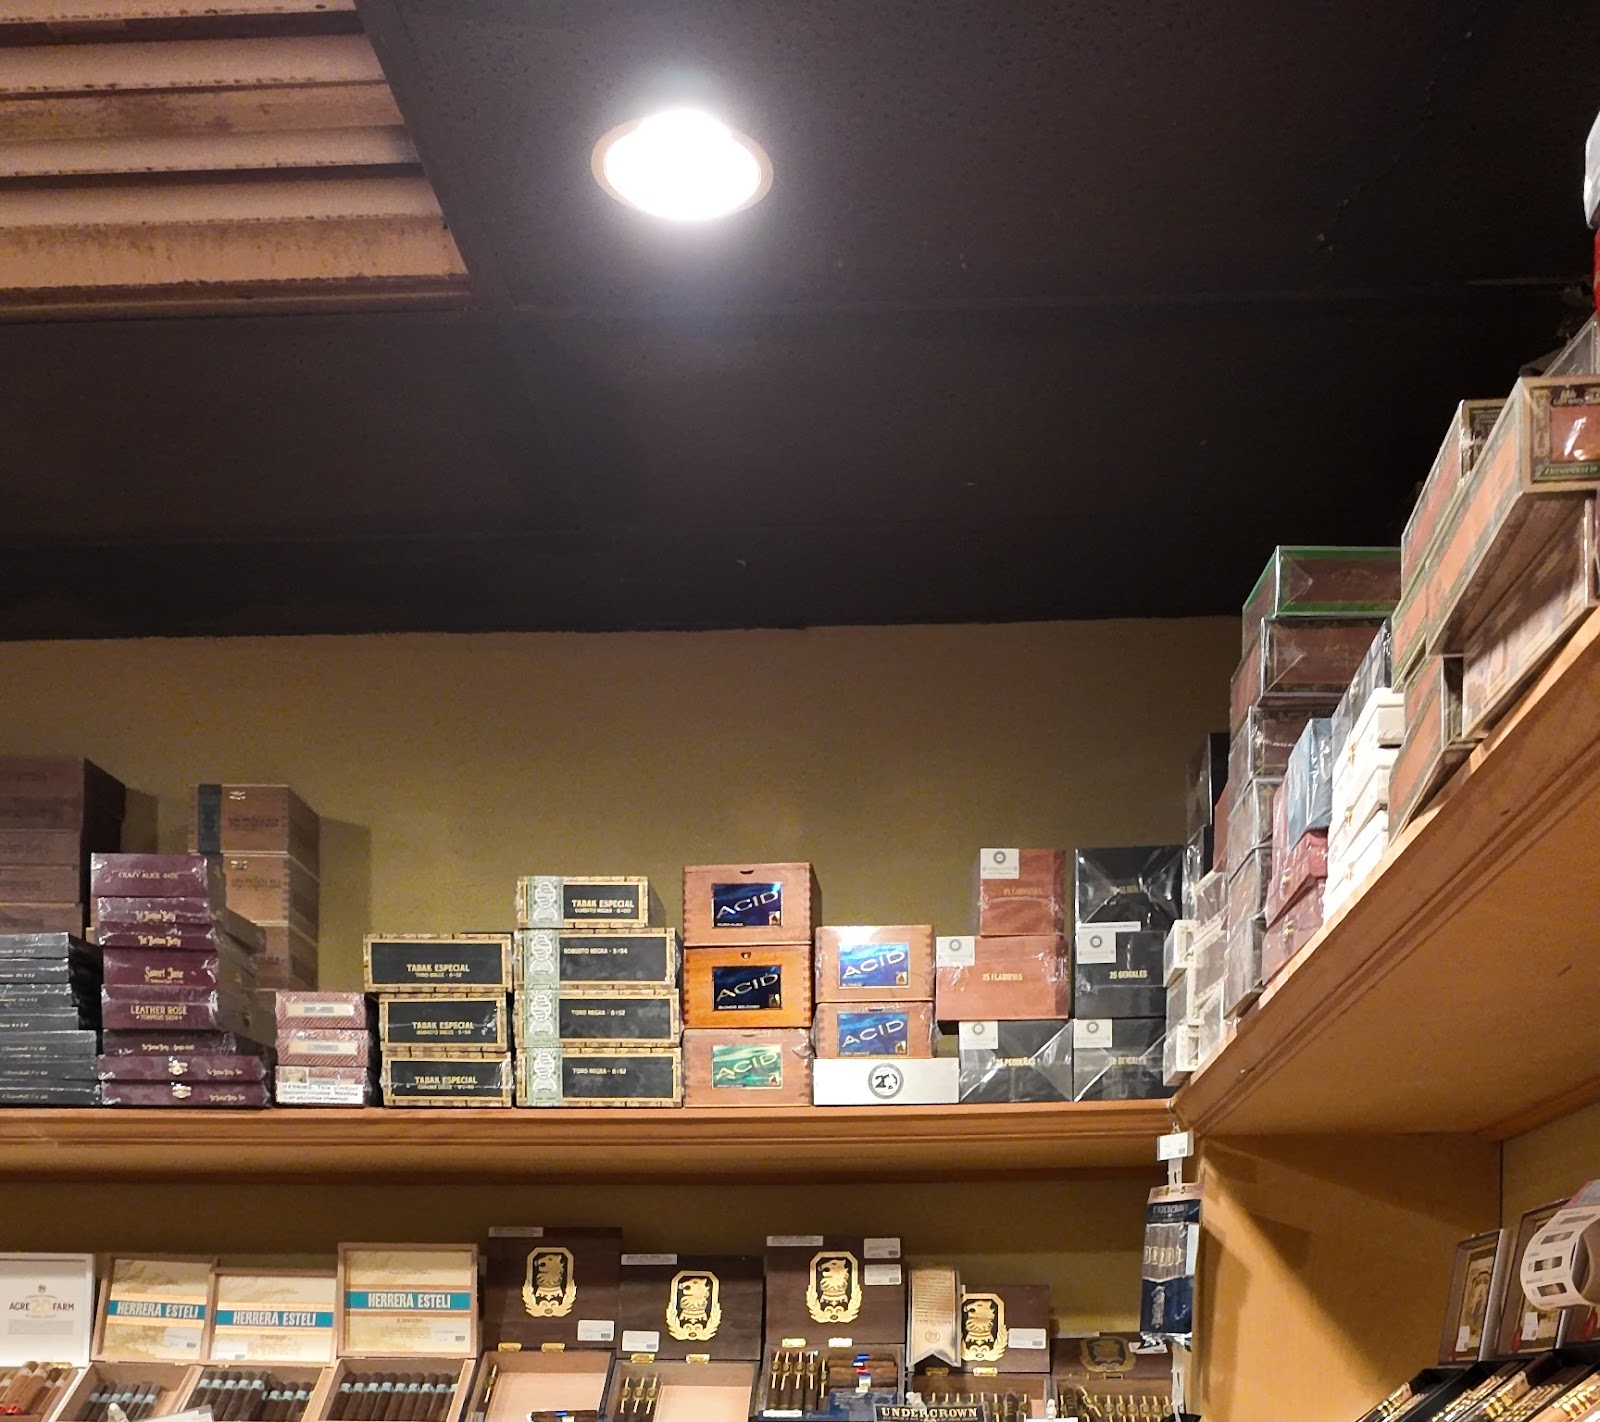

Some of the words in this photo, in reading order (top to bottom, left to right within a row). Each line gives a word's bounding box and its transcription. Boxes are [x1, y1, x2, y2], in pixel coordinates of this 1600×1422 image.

[571, 899, 597, 908] TABAK
[599, 899, 634, 908] ESPECIAL
[716, 891, 779, 919] ACID
[406, 964, 432, 973] TABAK
[434, 963, 470, 972] ESPECIAL
[843, 951, 907, 979] ACID
[716, 973, 779, 1001] ACID
[130, 1005, 166, 1015] LEATHER
[411, 1021, 437, 1030] TABAK
[439, 1021, 475, 1030] ESPECIAL
[842, 1020, 904, 1048] ACID
[716, 1052, 778, 1080] ACID
[414, 1076, 440, 1085] TABAK
[442, 1076, 478, 1084] ESPECIAL
[52, 1302, 75, 1311] FARM
[367, 1292, 414, 1308] HERRERA
[417, 1293, 451, 1309] ESTELI
[116, 1301, 162, 1317] HERRERA
[165, 1303, 200, 1319] ESTELI
[232, 1310, 279, 1326] HERRERA
[282, 1312, 317, 1327] ESTELI
[881, 1406, 978, 1419] UNDERCROWN
